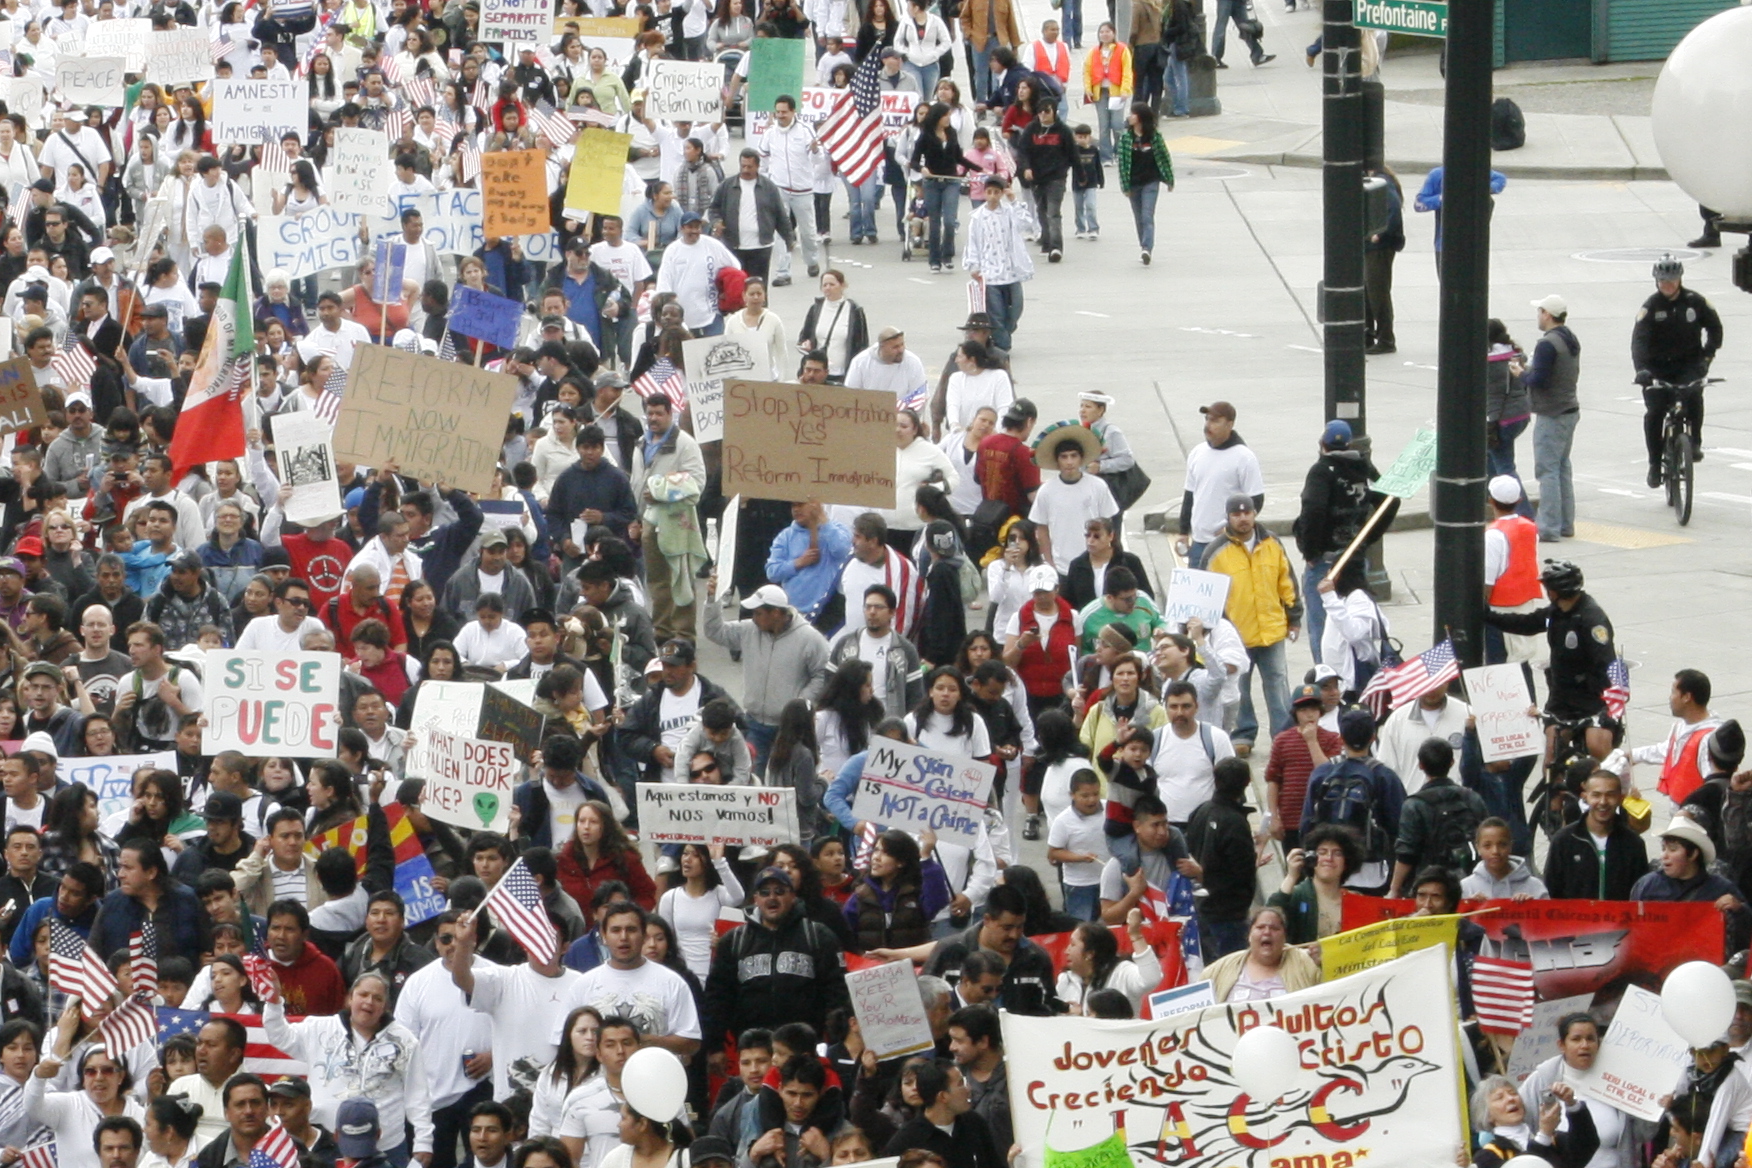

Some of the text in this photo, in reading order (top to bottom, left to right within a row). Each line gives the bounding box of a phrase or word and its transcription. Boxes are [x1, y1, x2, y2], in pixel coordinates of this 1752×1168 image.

[484, 13, 547, 25] SEPARATE
[1357, 0, 1436, 31] Prefontaine
[484, 28, 537, 41] FAMILYS
[61, 69, 115, 89] PEACE
[223, 84, 298, 100] AMNESTY
[652, 63, 722, 93] Emigration
[351, 343, 491, 407] REFORM
[11, 383, 30, 399] IS
[729, 384, 897, 425] Stop Deportation
[406, 408, 460, 431] NOW
[336, 408, 497, 476] IMMIGRATION
[726, 445, 801, 485] Reform
[224, 657, 322, 693] SI SE
[211, 696, 335, 750] PUEDE
[429, 728, 511, 767] WHAT DOES
[465, 763, 511, 791] LOOK
[872, 748, 954, 784] My Skin
[678, 789, 780, 807] estamos y NO
[879, 792, 921, 820] NOT
[668, 809, 703, 822] NOS
[855, 979, 899, 997] KEEP
